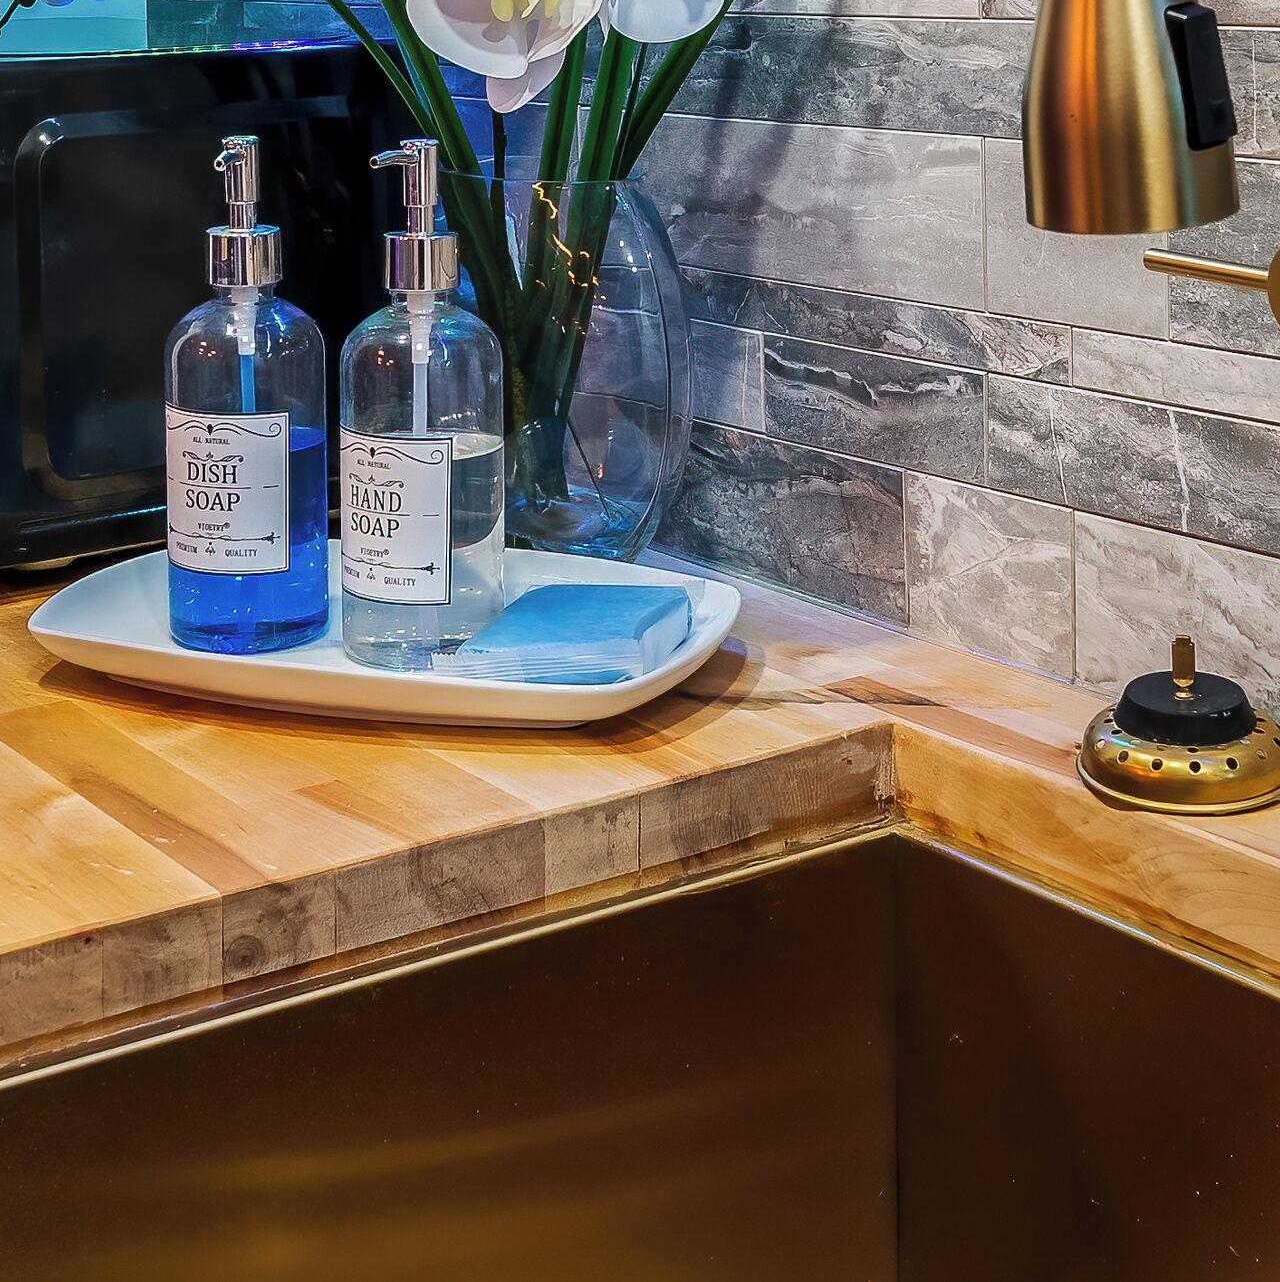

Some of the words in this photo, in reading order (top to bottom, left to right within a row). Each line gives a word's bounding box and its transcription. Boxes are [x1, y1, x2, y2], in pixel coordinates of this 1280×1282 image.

[192, 436, 202, 444] ALL
[205, 437, 231, 445] NATURAL
[187, 461, 238, 484] DISH
[367, 461, 391, 470] NATURAL
[185, 488, 241, 512] SOAP
[350, 484, 402, 513] HAND
[350, 512, 400, 539] SOAP
[176, 541, 198, 554] PREMIUM
[224, 548, 258, 557] QUALITY
[383, 576, 417, 587] QUALITY
